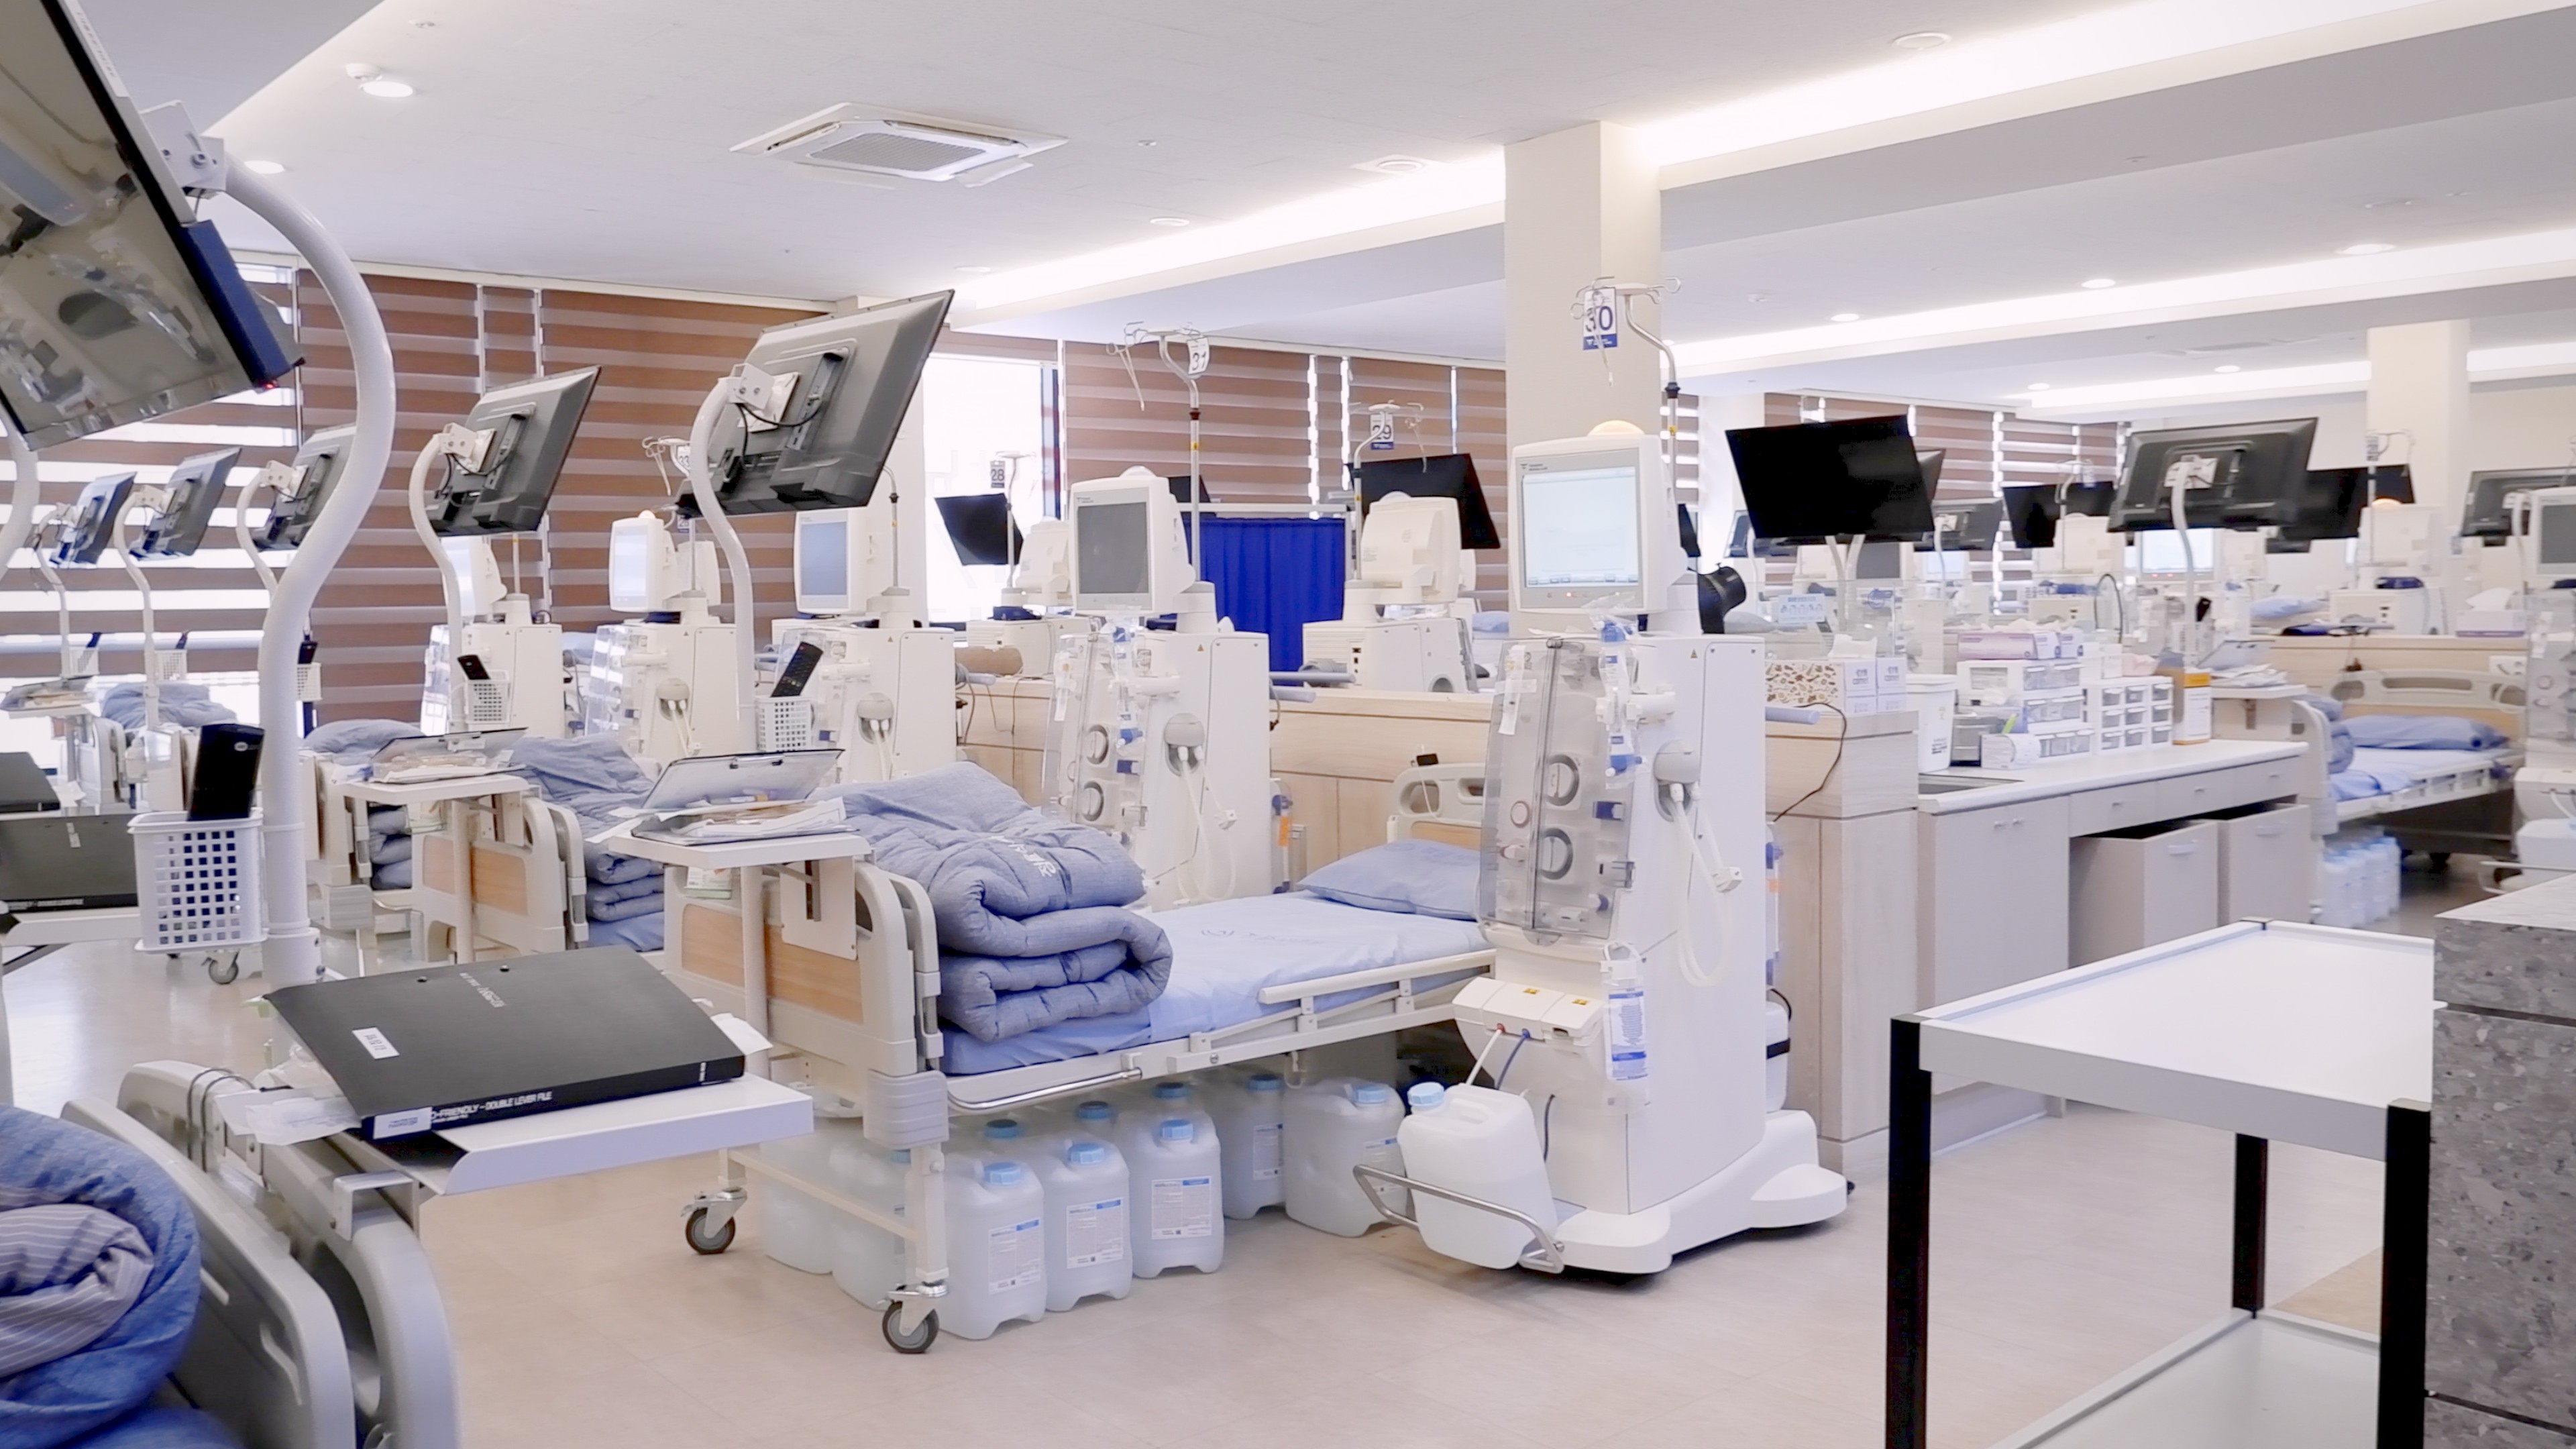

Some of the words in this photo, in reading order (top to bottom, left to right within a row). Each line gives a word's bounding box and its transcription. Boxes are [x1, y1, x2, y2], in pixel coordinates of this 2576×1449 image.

[1585, 306, 1613, 332] 30
[1373, 425, 1392, 439] 29
[991, 469, 1005, 481] 28
[431, 1104, 480, 1120] O-FRIENDLY
[486, 1097, 515, 1111] DOUBLE
[515, 1093, 537, 1106] LEVER
[537, 1091, 553, 1102] FILE
